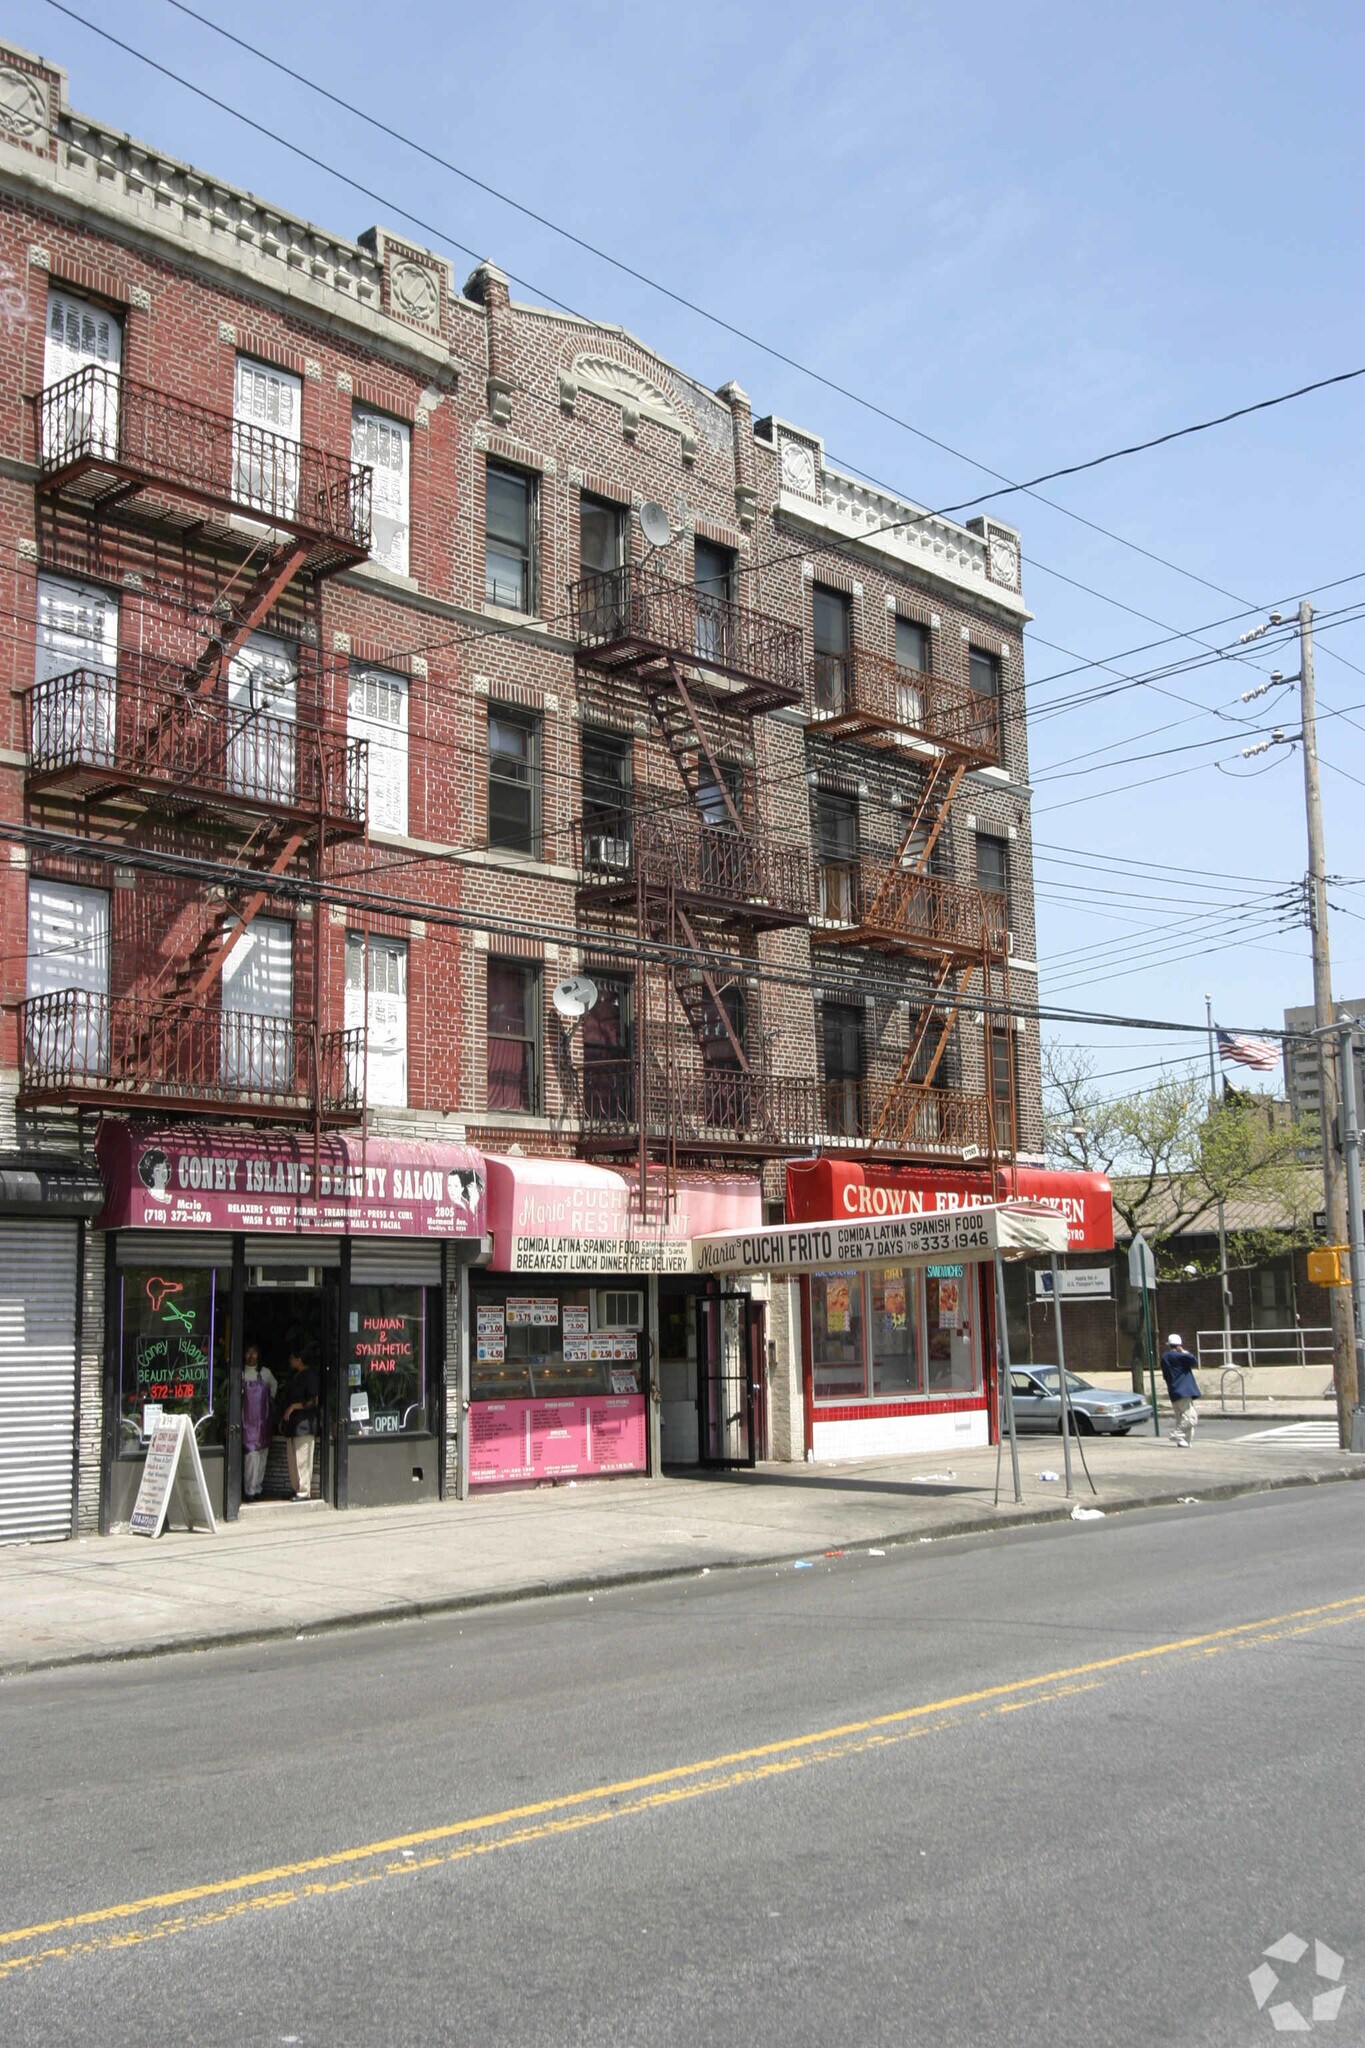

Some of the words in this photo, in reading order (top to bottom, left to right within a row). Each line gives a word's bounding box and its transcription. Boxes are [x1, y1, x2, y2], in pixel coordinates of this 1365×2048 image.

[178, 1156, 238, 1190] CONEY
[246, 1160, 312, 1194] ISLAND
[320, 1164, 386, 1198] BEAUTY
[393, 1169, 443, 1201] SALON
[843, 1183, 923, 1215] CROWN
[144, 1209, 167, 1224] (718)
[170, 1210, 212, 1223] 372-1678
[228, 1204, 263, 1214] RELAXERS
[270, 1206, 291, 1216] CURLY
[294, 1207, 317, 1216] PERMS
[324, 1207, 361, 1218] TREATMENT
[367, 1209, 387, 1219] PRESS
[389, 1210, 395, 1219] &
[398, 1211, 413, 1220] CURL
[435, 1206, 455, 1218] 2805
[242, 1215, 263, 1225] WASH
[266, 1216, 272, 1225] &
[275, 1217, 287, 1226] SET
[293, 1217, 310, 1227] HAIR
[350, 1219, 369, 1228] NAILS
[372, 1220, 377, 1229] &
[380, 1220, 401, 1230] FACIAL
[838, 1228, 871, 1243] COMIDA
[873, 1224, 907, 1241] LATINA
[910, 1218, 950, 1237] SPANISH
[955, 1214, 983, 1231] FOOD
[517, 1237, 549, 1253] COMIDA
[619, 1239, 640, 1255] FOOD
[743, 1235, 784, 1266] CUCHI
[789, 1230, 832, 1262] FRITO
[838, 1244, 863, 1259] OPEN
[865, 1242, 874, 1257] 7
[878, 1239, 903, 1256] DAYS
[516, 1254, 568, 1271] BREAKFAST
[570, 1255, 598, 1270] LUNCH
[600, 1256, 628, 1271] DINNER
[630, 1256, 649, 1271] FREE
[652, 1256, 687, 1272] DELIVERY
[927, 1264, 964, 1278] SANDWICHES
[363, 1318, 405, 1330] HUMAN
[379, 1330, 387, 1343] &
[137, 1339, 168, 1367] Coney
[178, 1337, 208, 1364] Island
[355, 1343, 411, 1356] SYNTHETIC
[370, 1359, 396, 1371] HAIR
[137, 1369, 175, 1383] BEAUTY
[178, 1367, 208, 1381] SALON
[150, 1383, 194, 1399] 372-1678
[374, 1415, 398, 1433] OPEN
